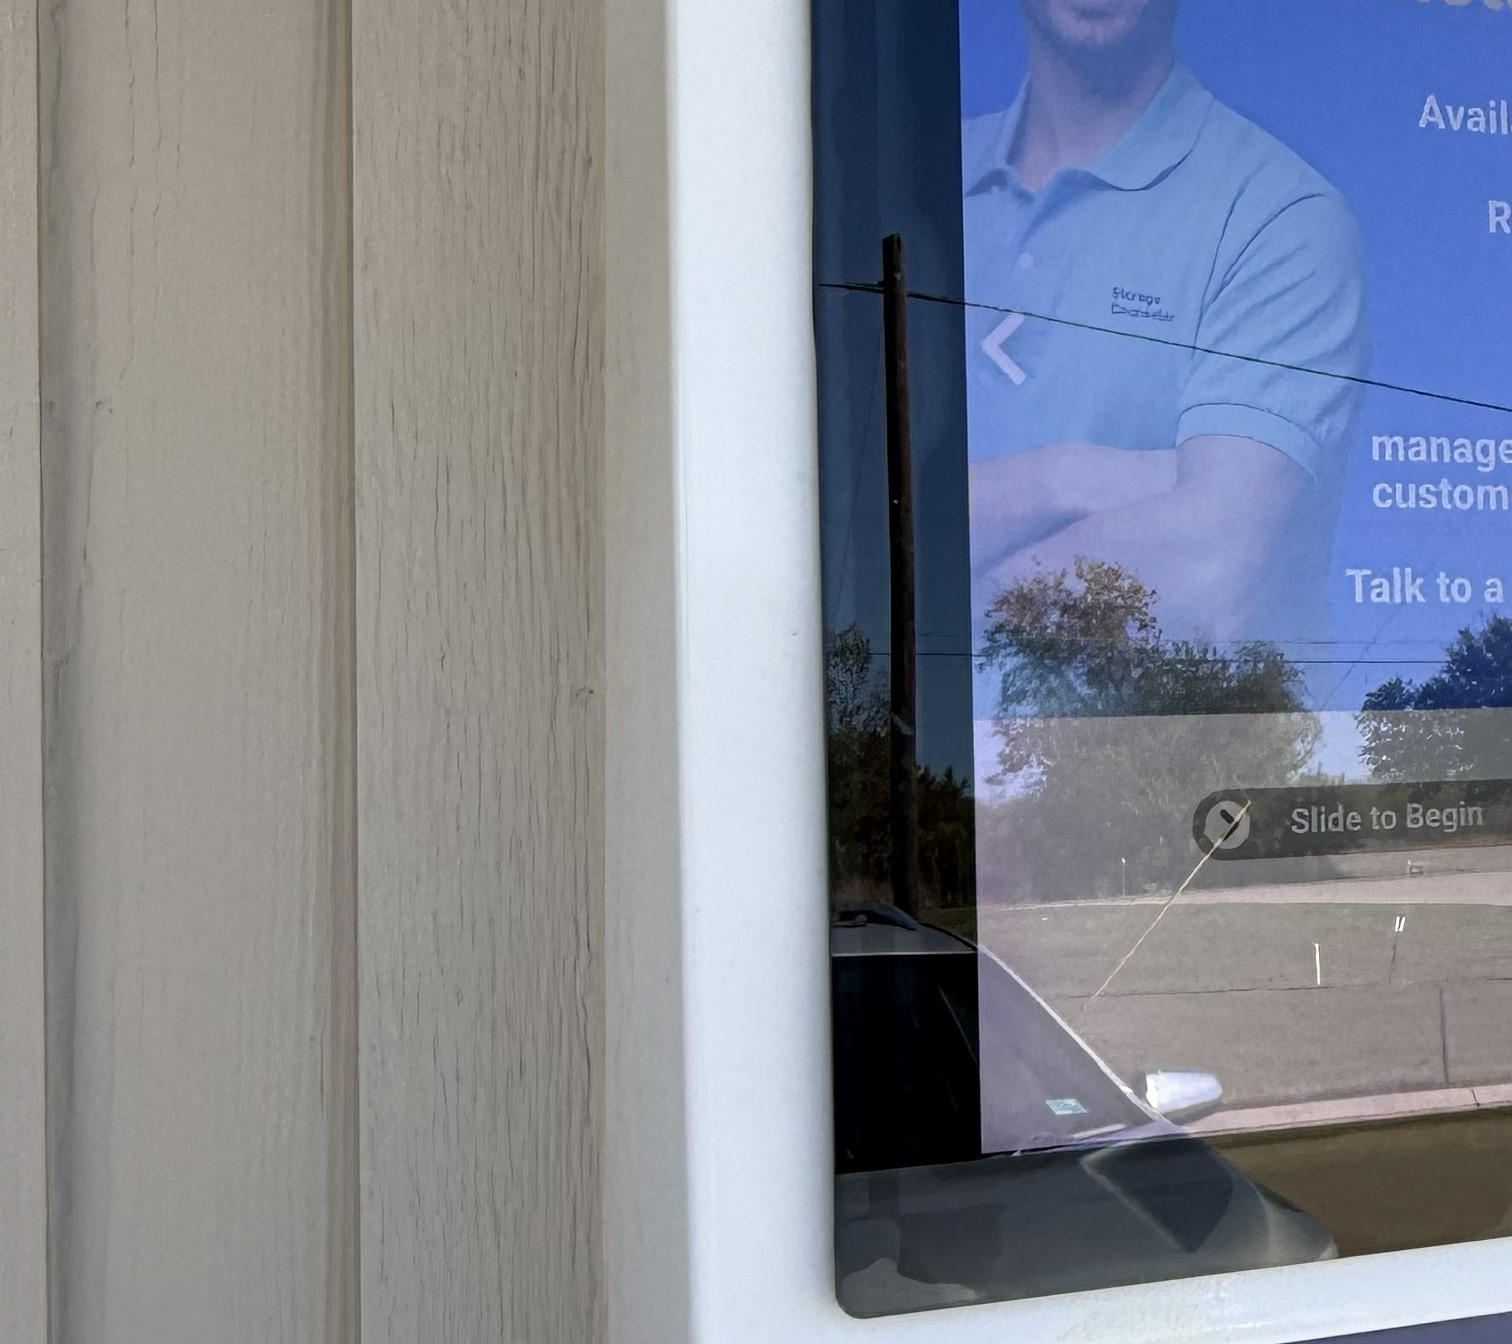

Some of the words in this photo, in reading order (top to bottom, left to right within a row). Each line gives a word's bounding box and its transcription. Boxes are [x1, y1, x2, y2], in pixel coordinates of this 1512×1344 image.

[1345, 567, 1426, 604] Talk
[1436, 572, 1473, 604] to
[1484, 576, 1504, 604] a
[1290, 805, 1362, 835] Slide
[1370, 806, 1397, 830] to
[1405, 800, 1484, 833] Begin
